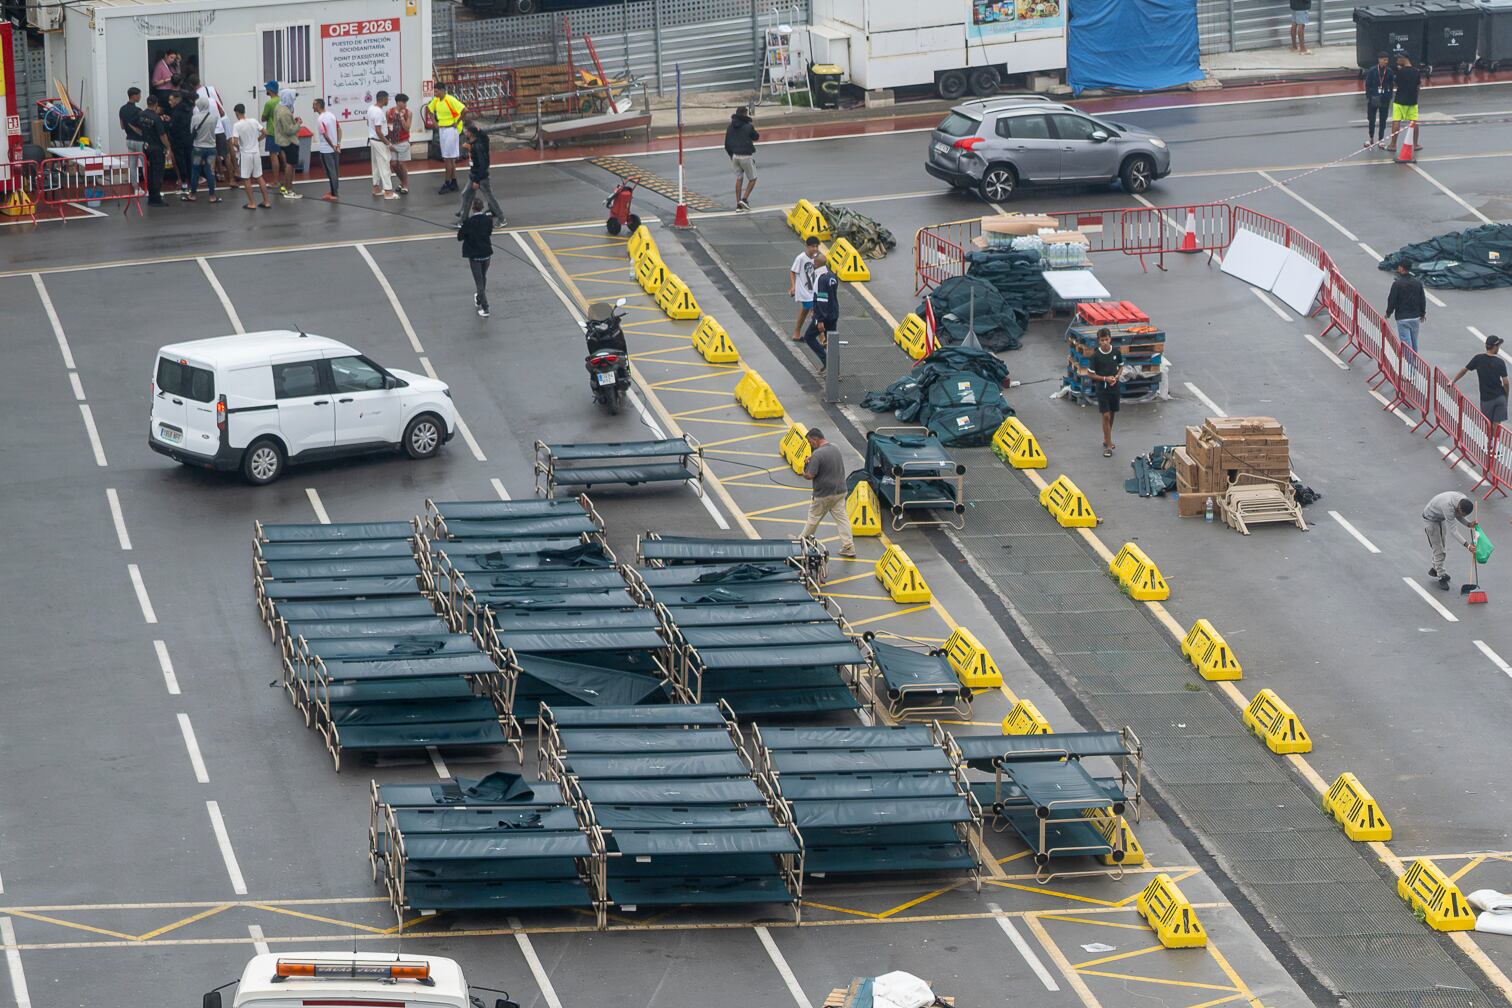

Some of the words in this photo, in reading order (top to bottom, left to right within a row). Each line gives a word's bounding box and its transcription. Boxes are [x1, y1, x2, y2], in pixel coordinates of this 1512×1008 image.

[328, 23, 359, 37] OPE
[362, 20, 393, 33] 2026
[363, 36, 391, 44] ATENCIÓN
[339, 45, 385, 53] SOCIOSANITARIA
[351, 52, 389, 60] D'ASSISTANCE
